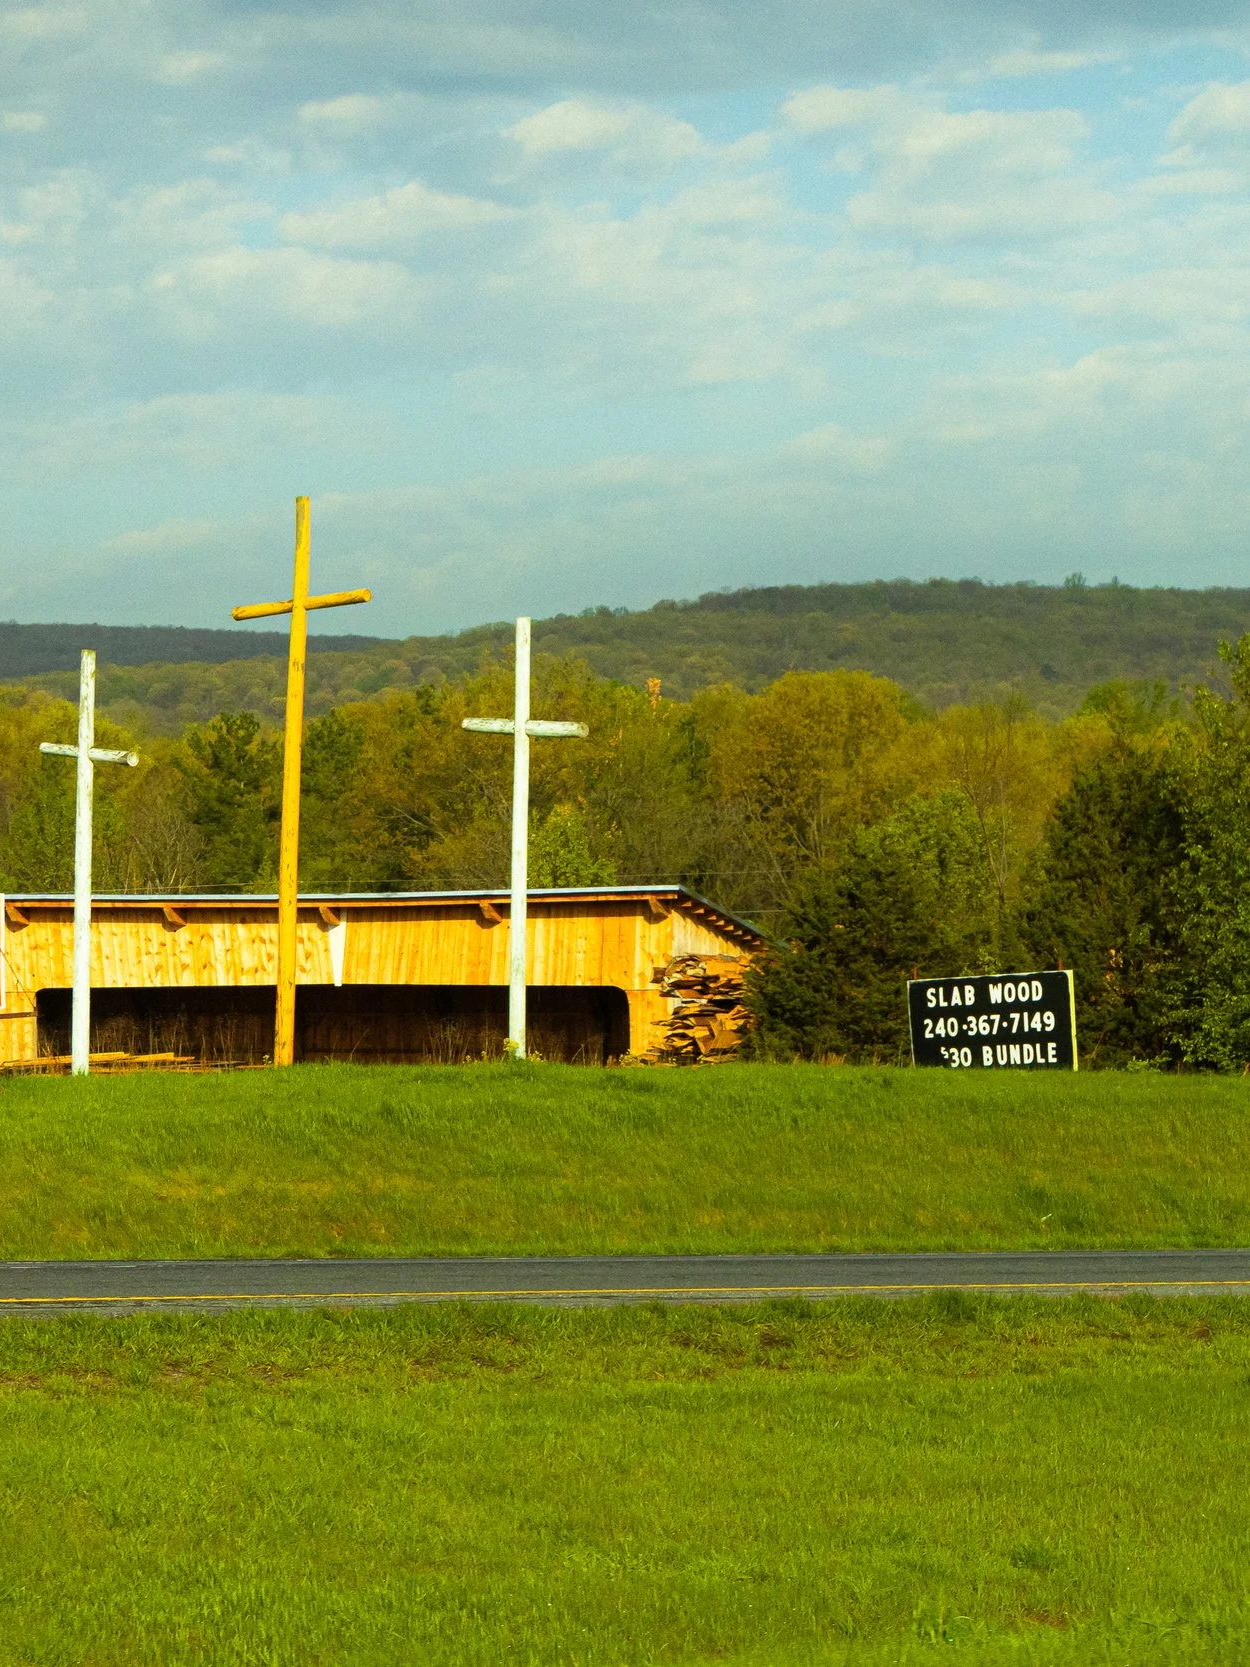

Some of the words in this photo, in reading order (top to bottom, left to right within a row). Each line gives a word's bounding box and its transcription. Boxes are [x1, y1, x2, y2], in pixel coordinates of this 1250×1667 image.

[926, 985, 976, 1008] SLAB
[989, 980, 1043, 1004] WOOD
[982, 1042, 1058, 1067] BUNDLE
